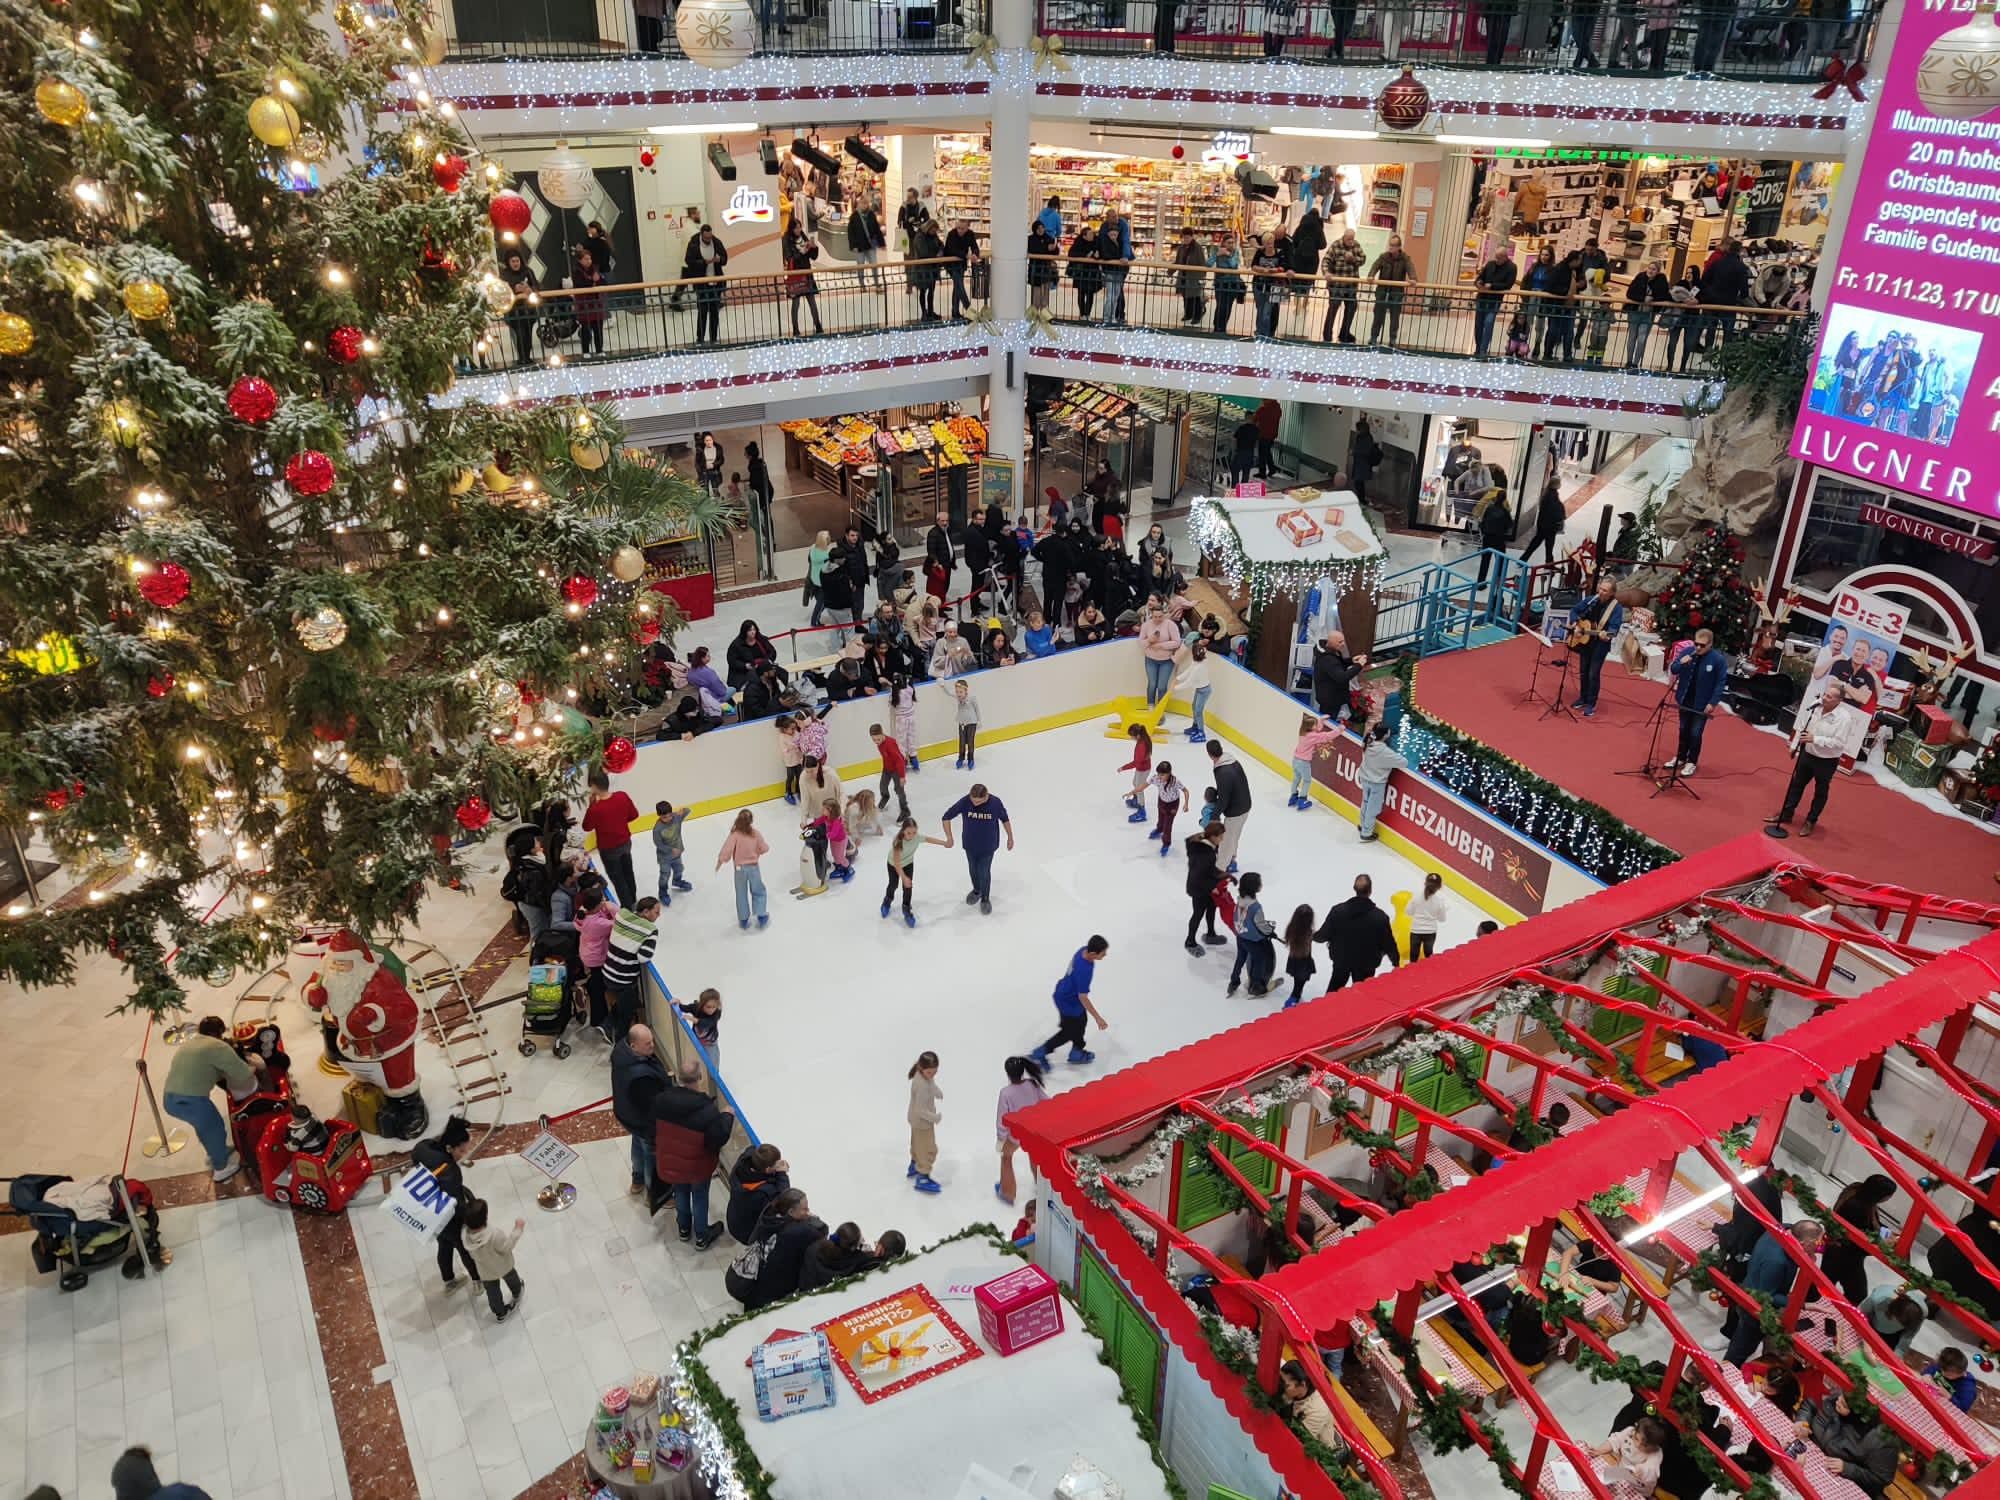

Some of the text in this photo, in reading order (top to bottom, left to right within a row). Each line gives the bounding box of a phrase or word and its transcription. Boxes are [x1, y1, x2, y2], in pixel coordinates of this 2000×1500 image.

[1892, 109, 2000, 145] Illuminierun
[1908, 141, 1934, 163] 20
[1935, 148, 1954, 165] m
[1879, 200, 1979, 229] gespendet
[1864, 222, 1928, 251] Familie
[1837, 266, 1859, 290] Fr.
[1863, 271, 1946, 309] 17.11.23,
[1952, 287, 1980, 311] 17
[1800, 425, 1972, 502] LUGNER
[1865, 507, 1984, 555] LUGNER CITY
[1883, 611, 1903, 635] 3
[967, 811, 993, 820] PARIS
[1399, 792, 1495, 872] EISZAUBER
[392, 1205, 428, 1233] ACTION
